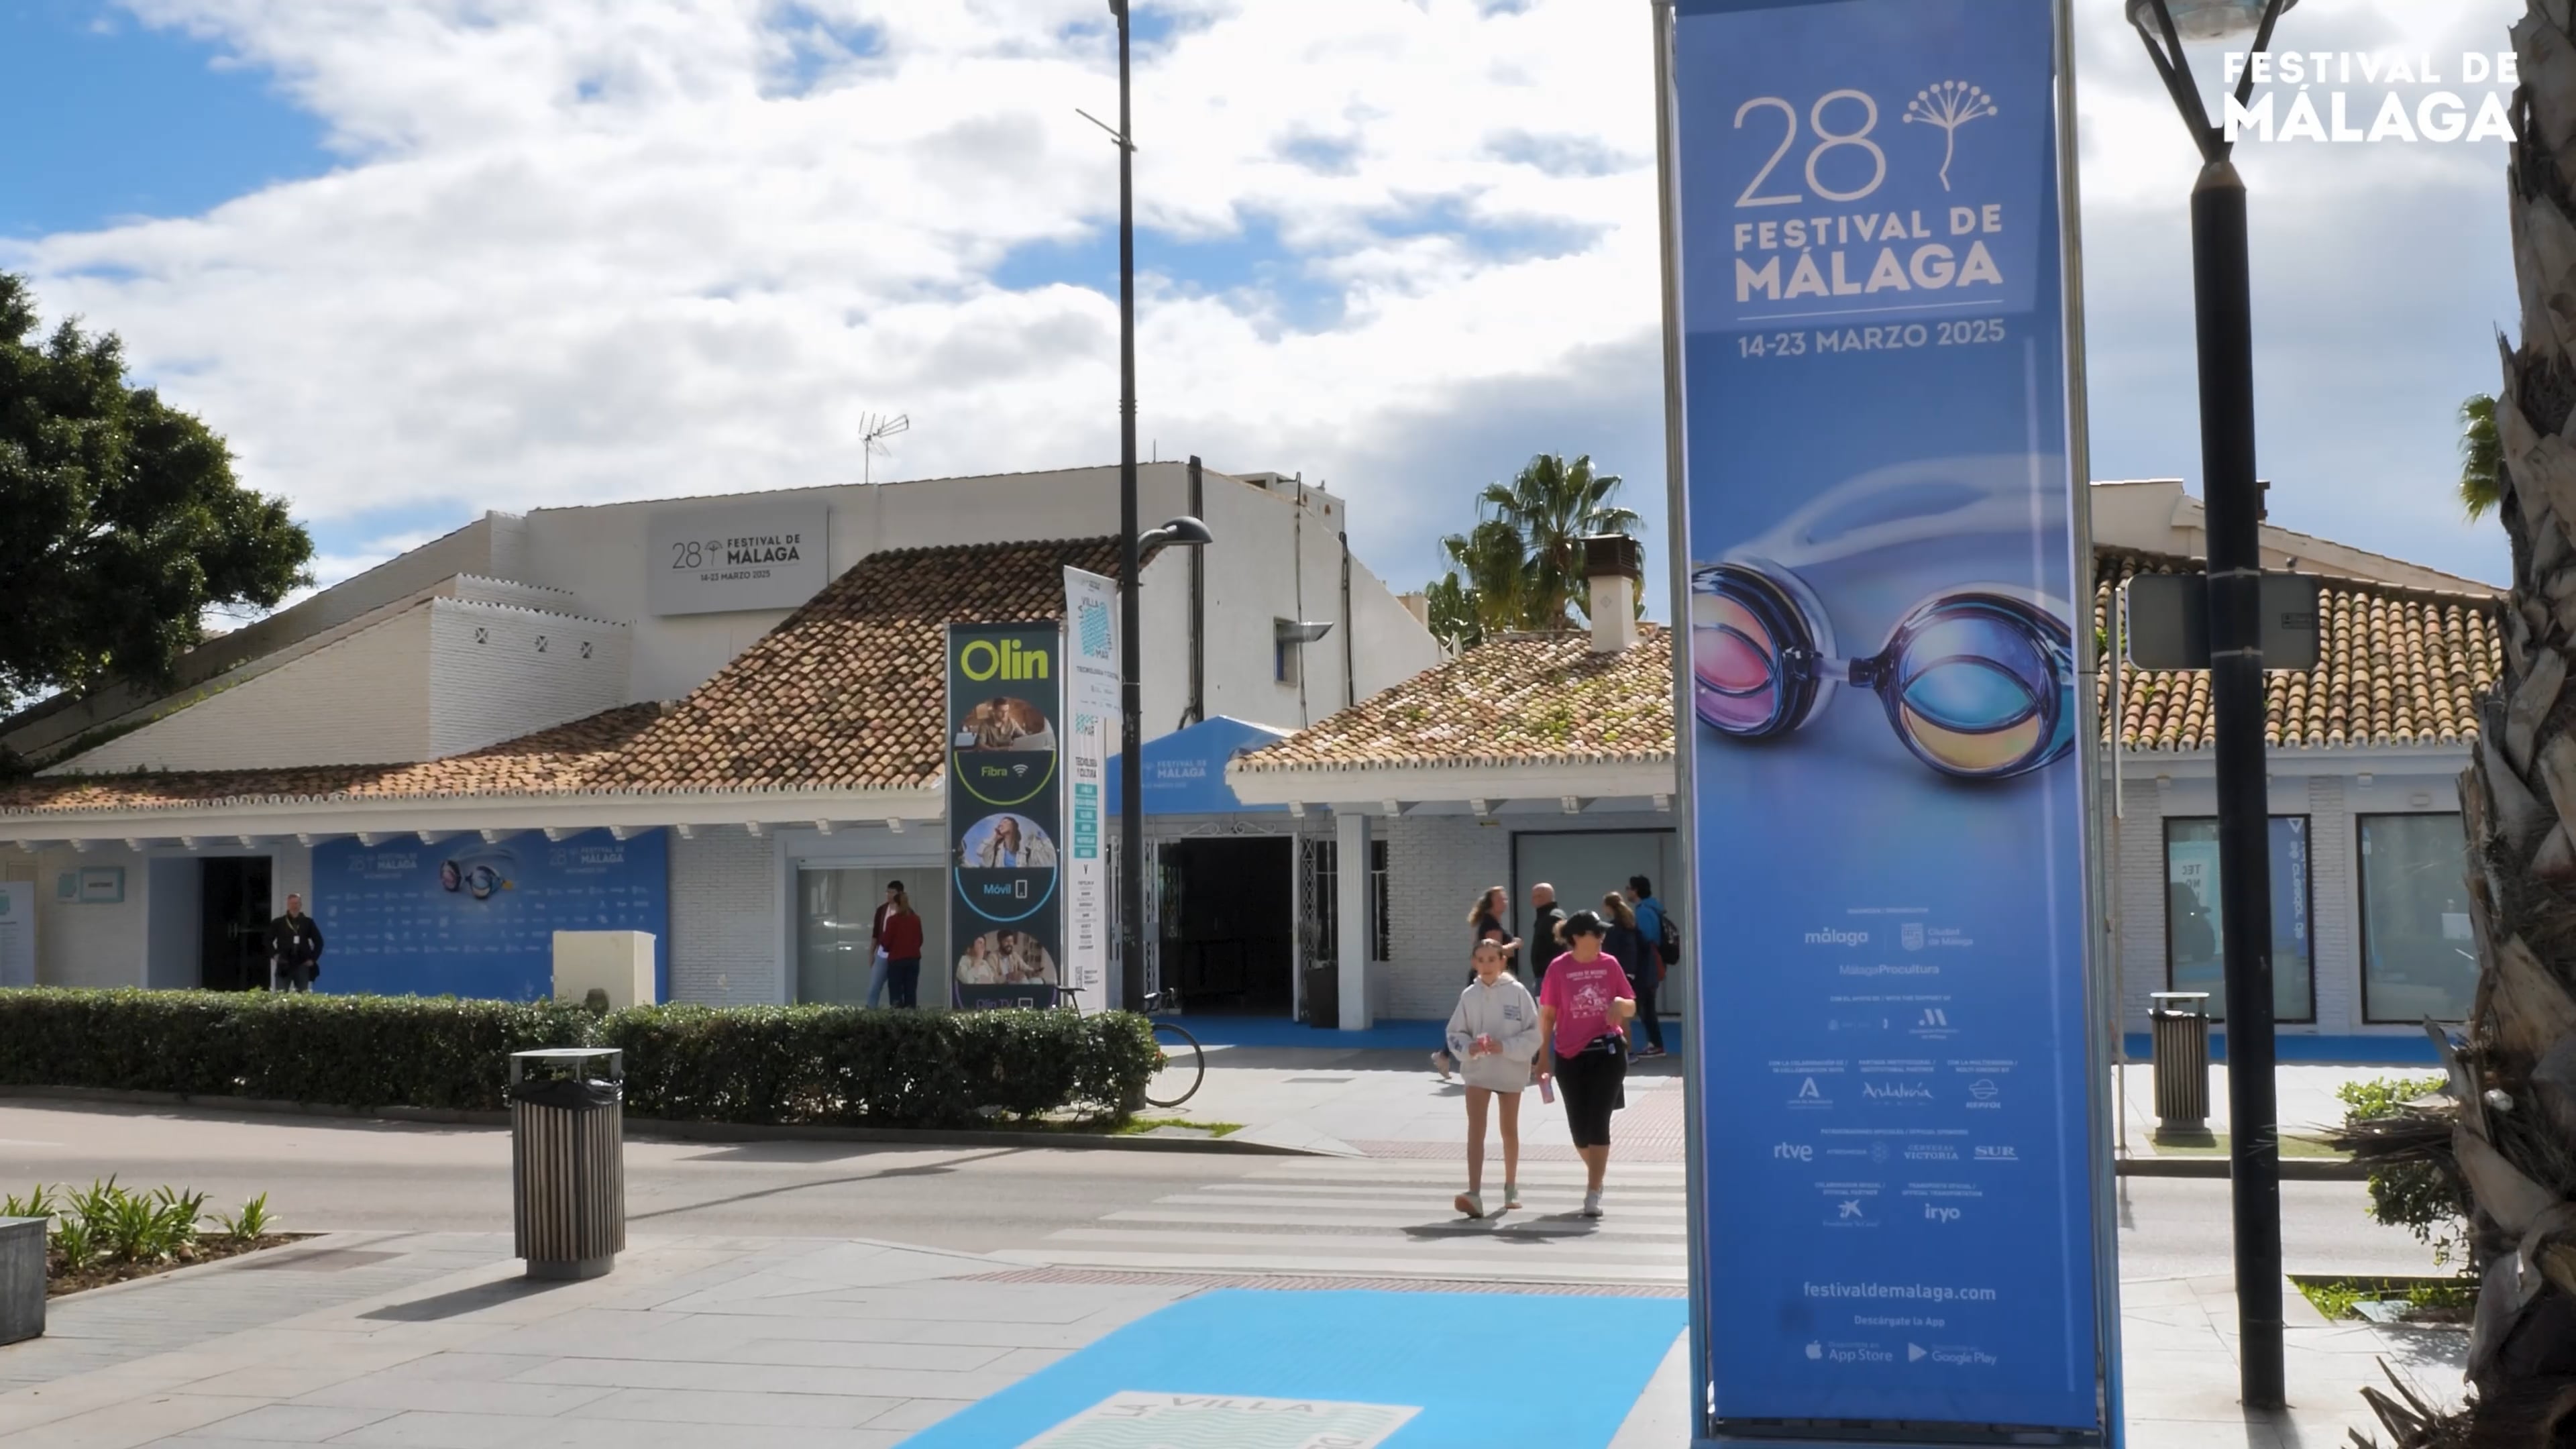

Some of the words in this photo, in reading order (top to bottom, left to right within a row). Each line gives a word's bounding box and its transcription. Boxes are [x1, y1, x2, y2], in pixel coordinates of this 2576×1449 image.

[1734, 89, 1886, 207] 28
[1734, 210, 1931, 252] FESTIVAL
[1950, 204, 2002, 235] DE
[1736, 240, 2003, 303] MÁLAGA
[1738, 332, 1806, 358] 14-23
[1817, 324, 1927, 354] MARZO
[1937, 319, 2005, 345] 2025
[728, 535, 781, 548] FESTIVAL
[786, 534, 800, 544] DE
[672, 541, 702, 569] 28
[720, 571, 750, 581] MARZO
[753, 570, 770, 579] 2025
[961, 639, 1049, 681] Olin
[981, 766, 1008, 777] Fibra
[983, 883, 1012, 895] Móvil
[999, 998, 1014, 1009] TV
[1774, 1142, 1813, 1161] rtve
[1904, 1151, 1959, 1160] VICTORIA
[1974, 1145, 2017, 1157] SUR
[1925, 1203, 1961, 1224] iryo
[1804, 1281, 1996, 1302] festivaldemalaga.com
[1854, 1314, 1911, 1328] Descárgate
[1913, 1316, 1923, 1326] la
[1925, 1317, 1945, 1328] App
[1829, 1348, 1856, 1363] App
[1858, 1348, 1893, 1362] Store
[1931, 1350, 1972, 1366] Google
[1974, 1352, 1997, 1366] Play
[1173, 1397, 1313, 1413] VILLA
